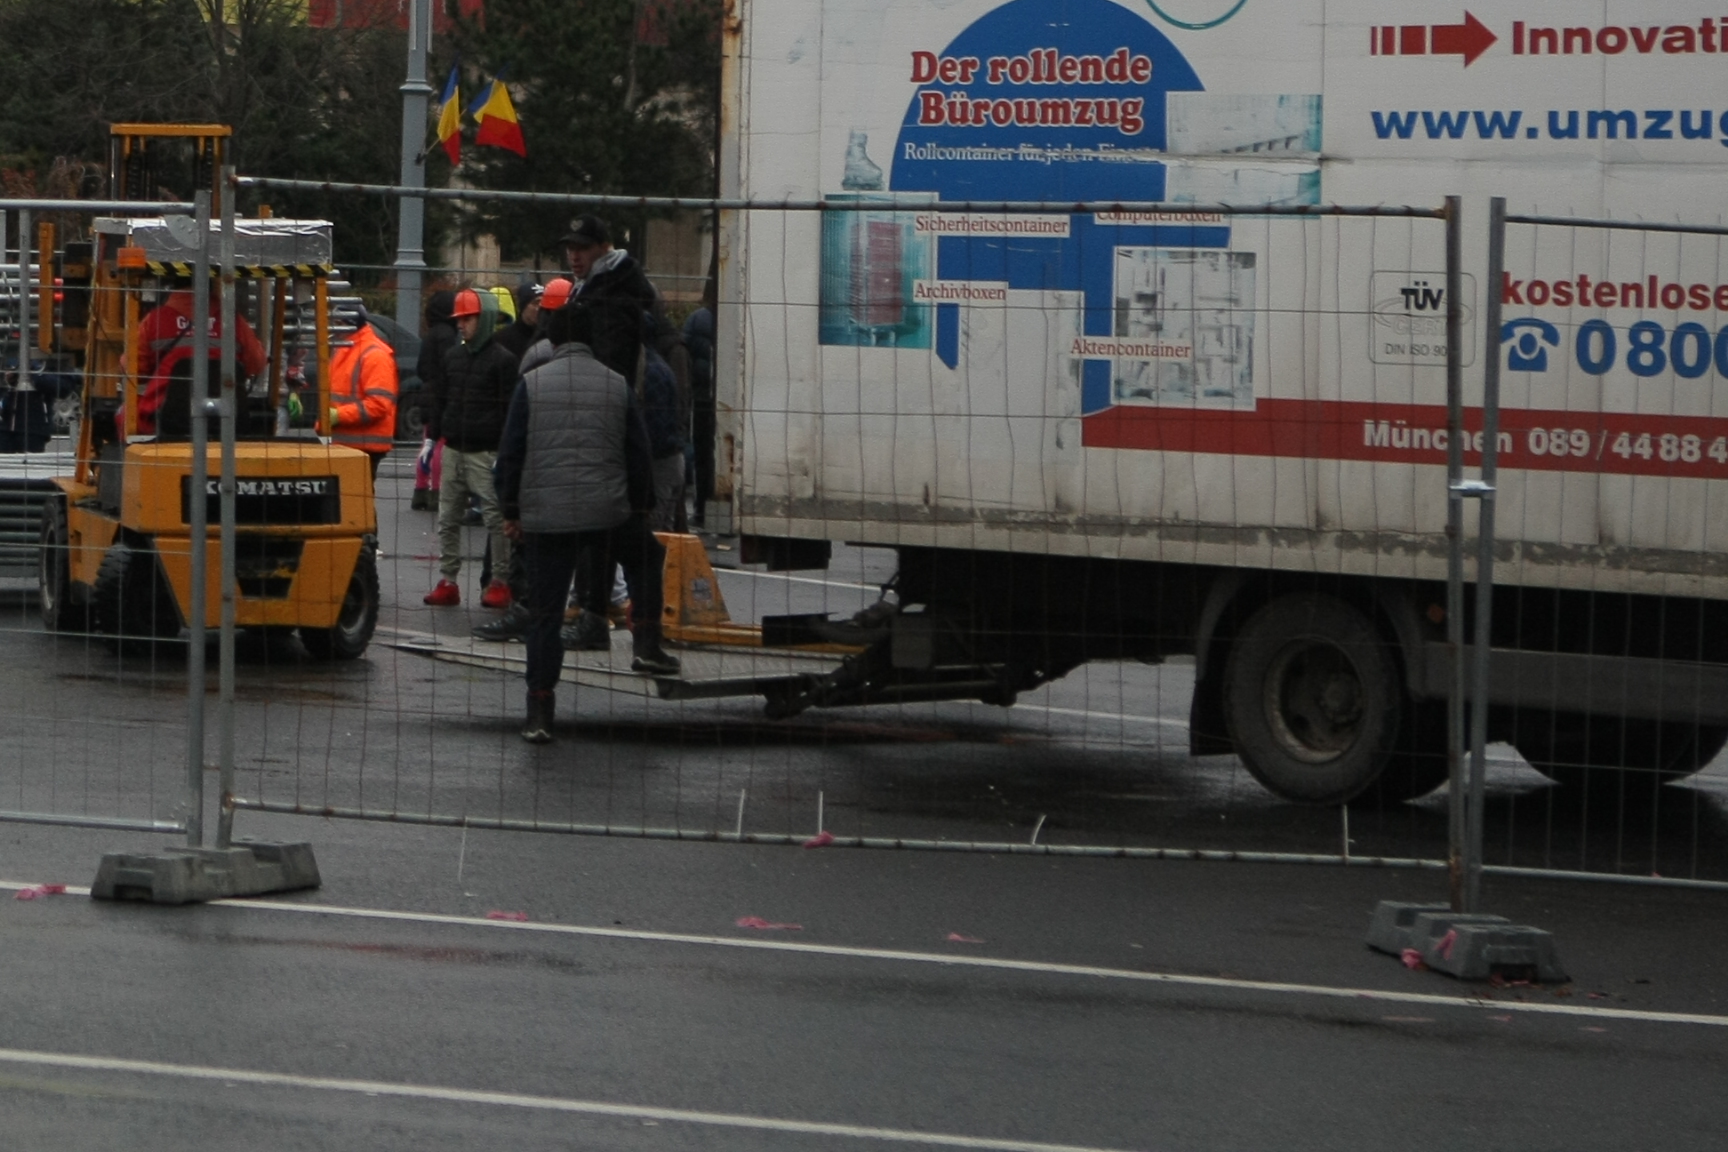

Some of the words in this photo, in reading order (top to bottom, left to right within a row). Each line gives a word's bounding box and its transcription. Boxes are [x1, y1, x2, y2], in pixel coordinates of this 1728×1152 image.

[909, 50, 980, 85] Der
[987, 47, 1153, 85] rollende
[918, 90, 1145, 135] Büroumzug
[903, 142, 1014, 162] Rollcontainer
[915, 215, 1069, 234] Sicherheitscontainer
[915, 282, 1007, 300] Archivboxen
[1400, 280, 1445, 312] TÜV
[1071, 338, 1191, 358] Aktencontainer
[1384, 342, 1405, 356] DIN
[1410, 343, 1430, 357] ISO
[205, 480, 328, 496] KMATSU
